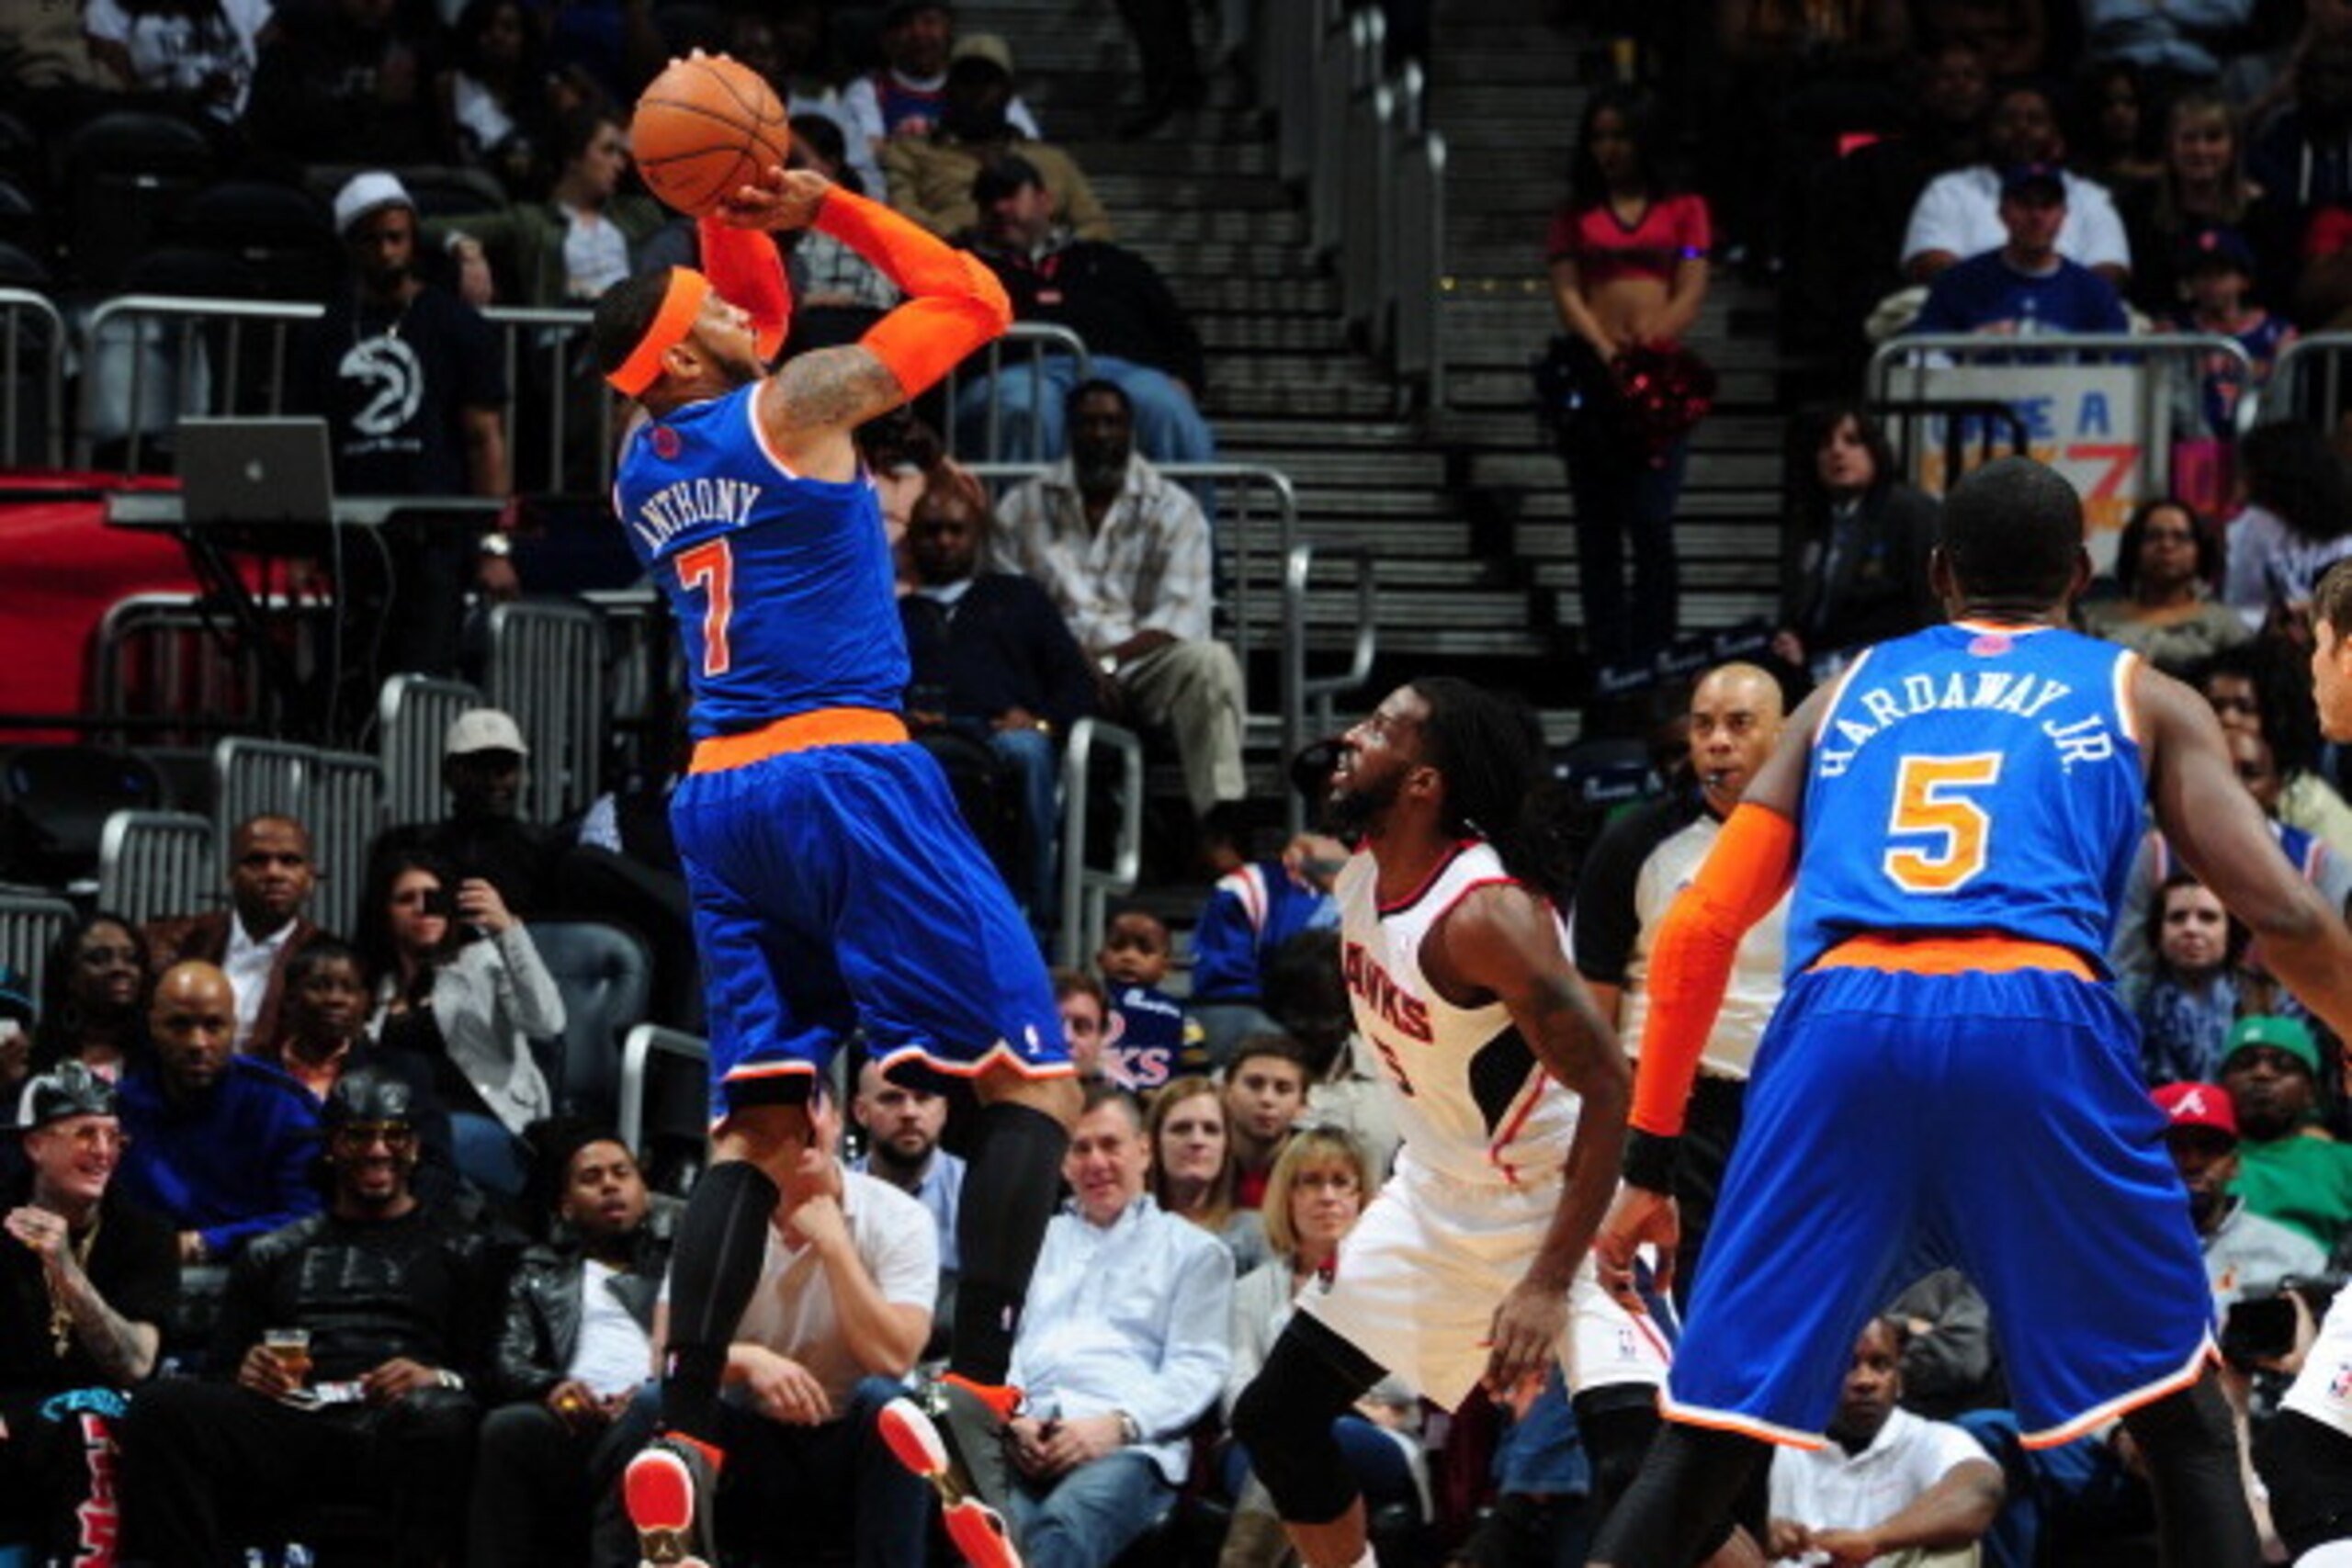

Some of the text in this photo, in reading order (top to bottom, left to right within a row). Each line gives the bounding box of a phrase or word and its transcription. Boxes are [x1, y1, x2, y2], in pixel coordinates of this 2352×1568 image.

[2078, 391, 2109, 437] A
[632, 478, 762, 558] ANTHONY
[673, 535, 732, 678] 7
[1820, 671, 2072, 777] HARDAWAY
[1883, 751, 2005, 893] 5
[1344, 941, 1435, 1044] AWKS
[1102, 1047, 1172, 1091] KS
[300, 1245, 421, 1290] FLY
